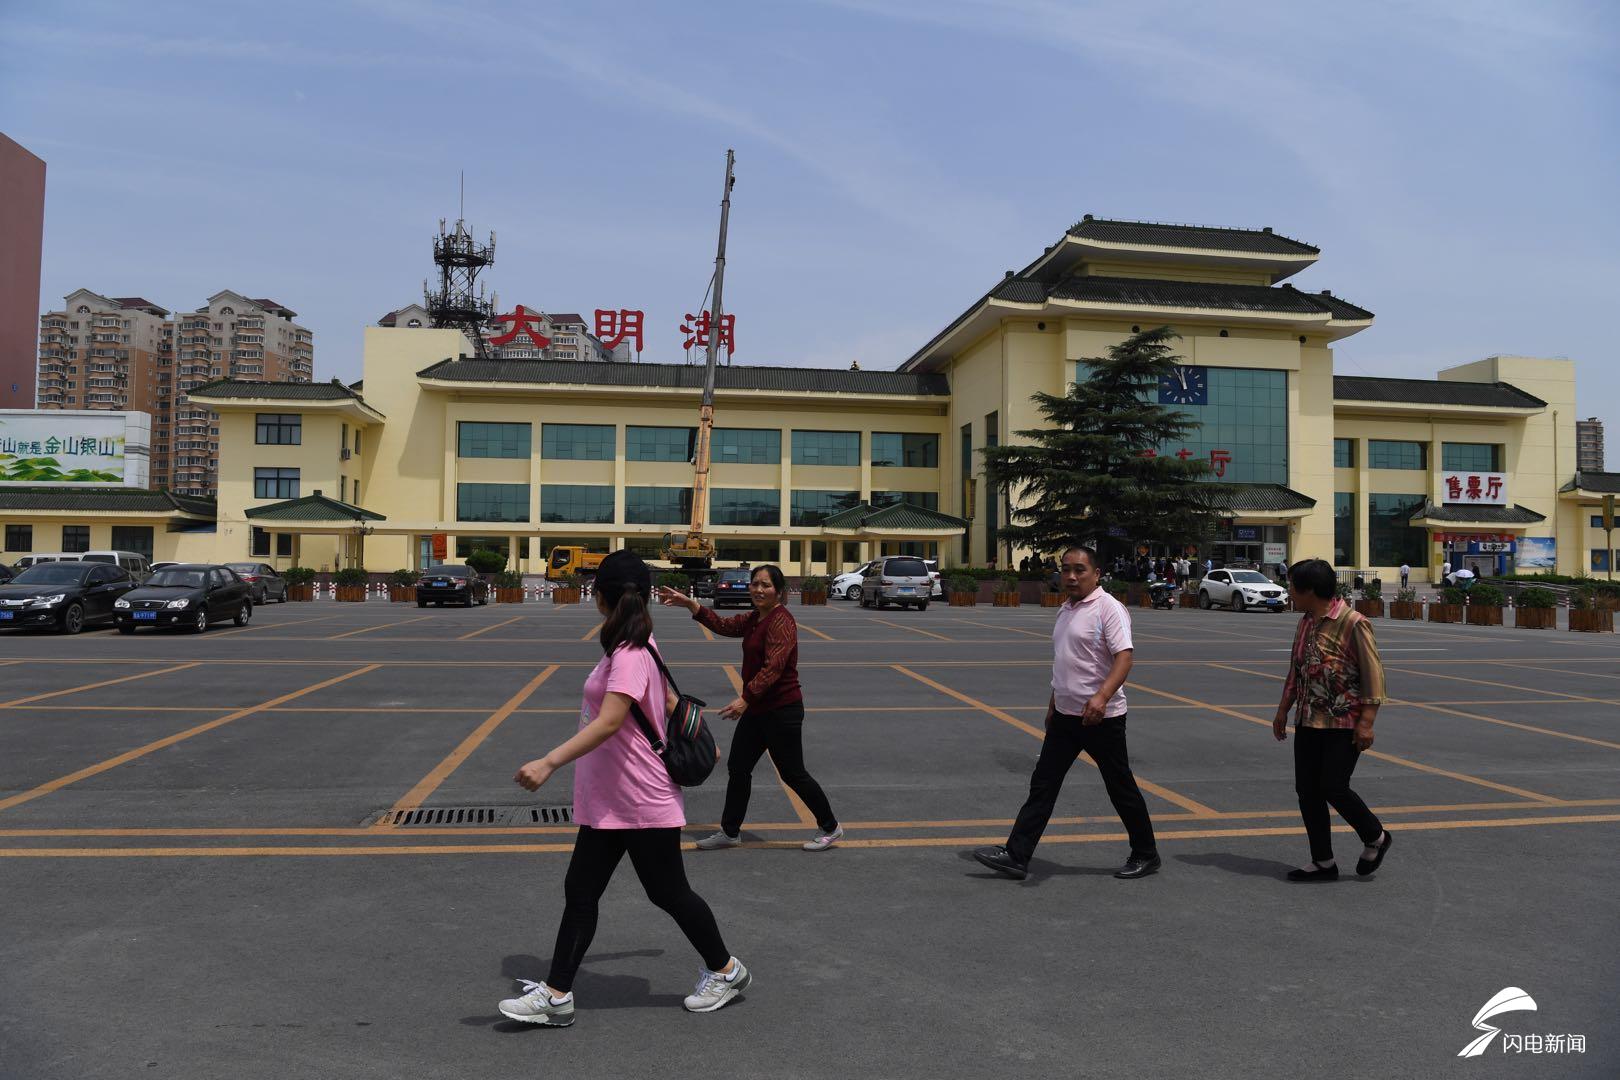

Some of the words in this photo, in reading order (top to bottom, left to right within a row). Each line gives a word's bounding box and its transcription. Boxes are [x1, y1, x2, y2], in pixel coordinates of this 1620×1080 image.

[489, 304, 735, 356] 大明湖
[0, 436, 114, 456] 山就是金山银山
[1446, 476, 1503, 499] 售票厅
